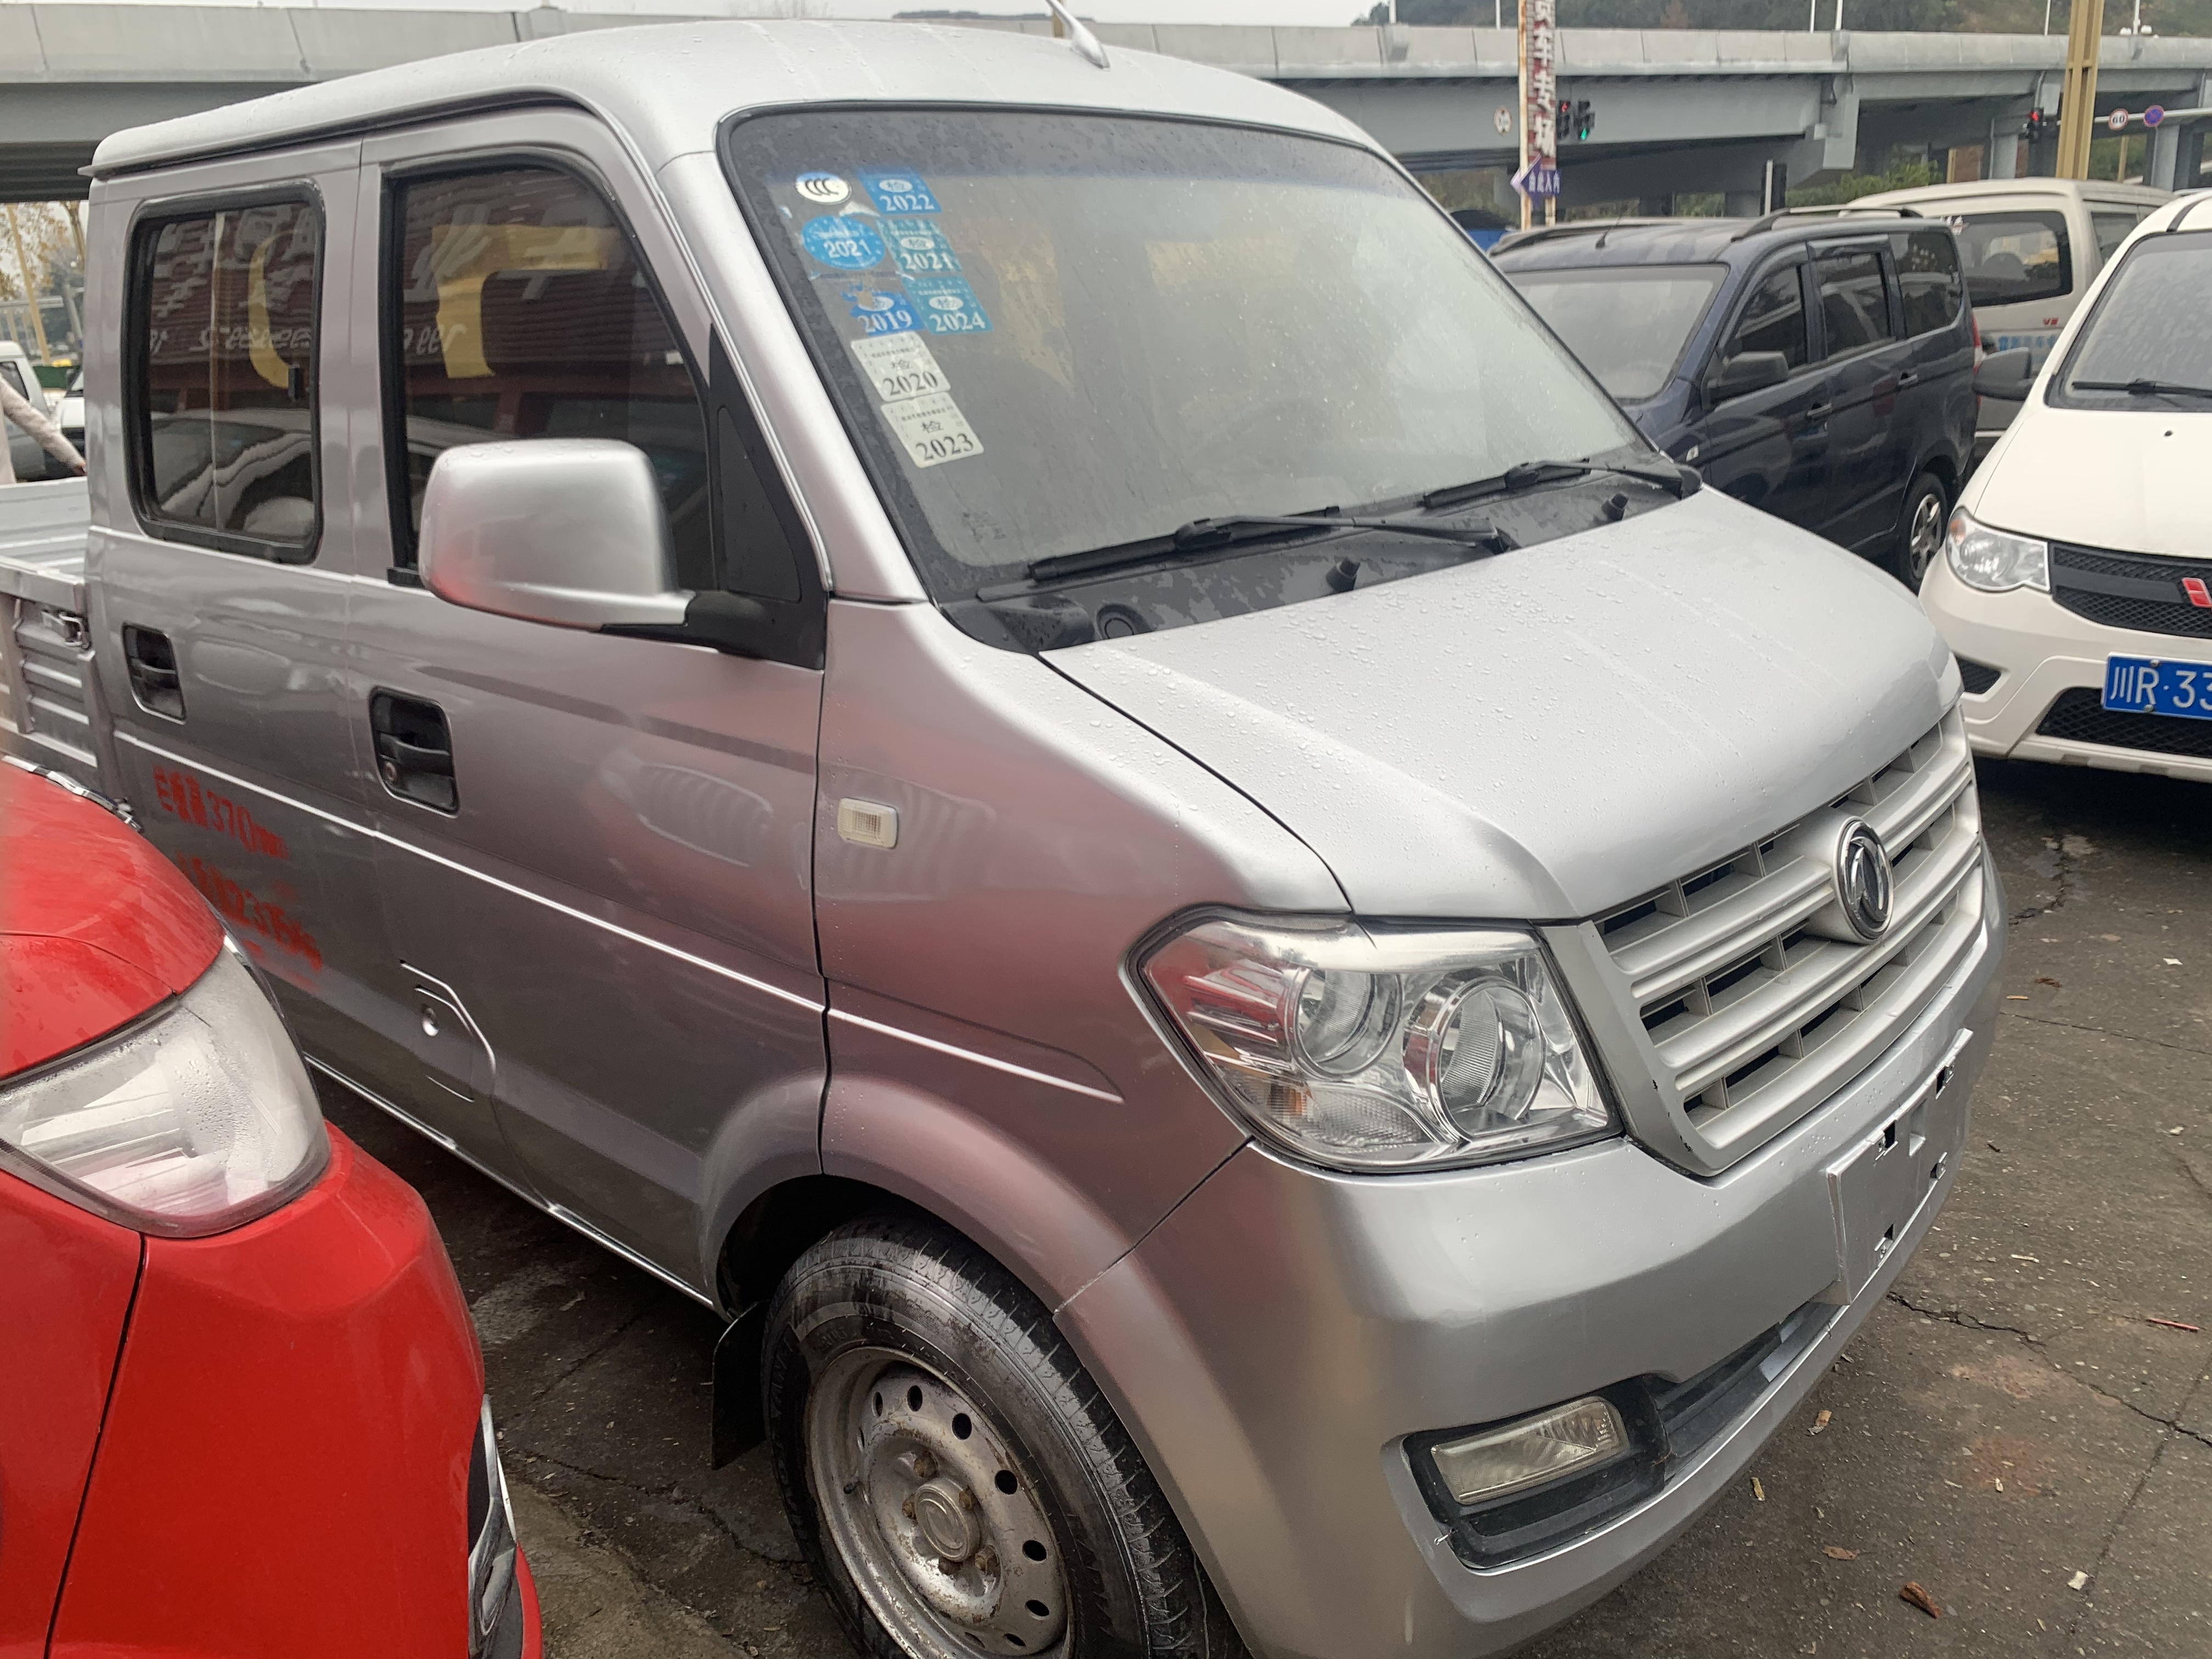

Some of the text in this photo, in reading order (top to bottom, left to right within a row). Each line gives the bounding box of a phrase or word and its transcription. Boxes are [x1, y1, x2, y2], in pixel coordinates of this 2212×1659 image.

[2112, 115, 2126, 125] 60
[879, 194, 935, 212] 2022
[823, 239, 872, 258] 2021
[900, 252, 954, 270] 2021
[857, 310, 913, 334] 2019
[929, 313, 986, 332] 2024
[890, 359, 913, 370] 检
[883, 371, 938, 396] 2020
[921, 420, 944, 433] 检
[916, 433, 974, 461] 2023
